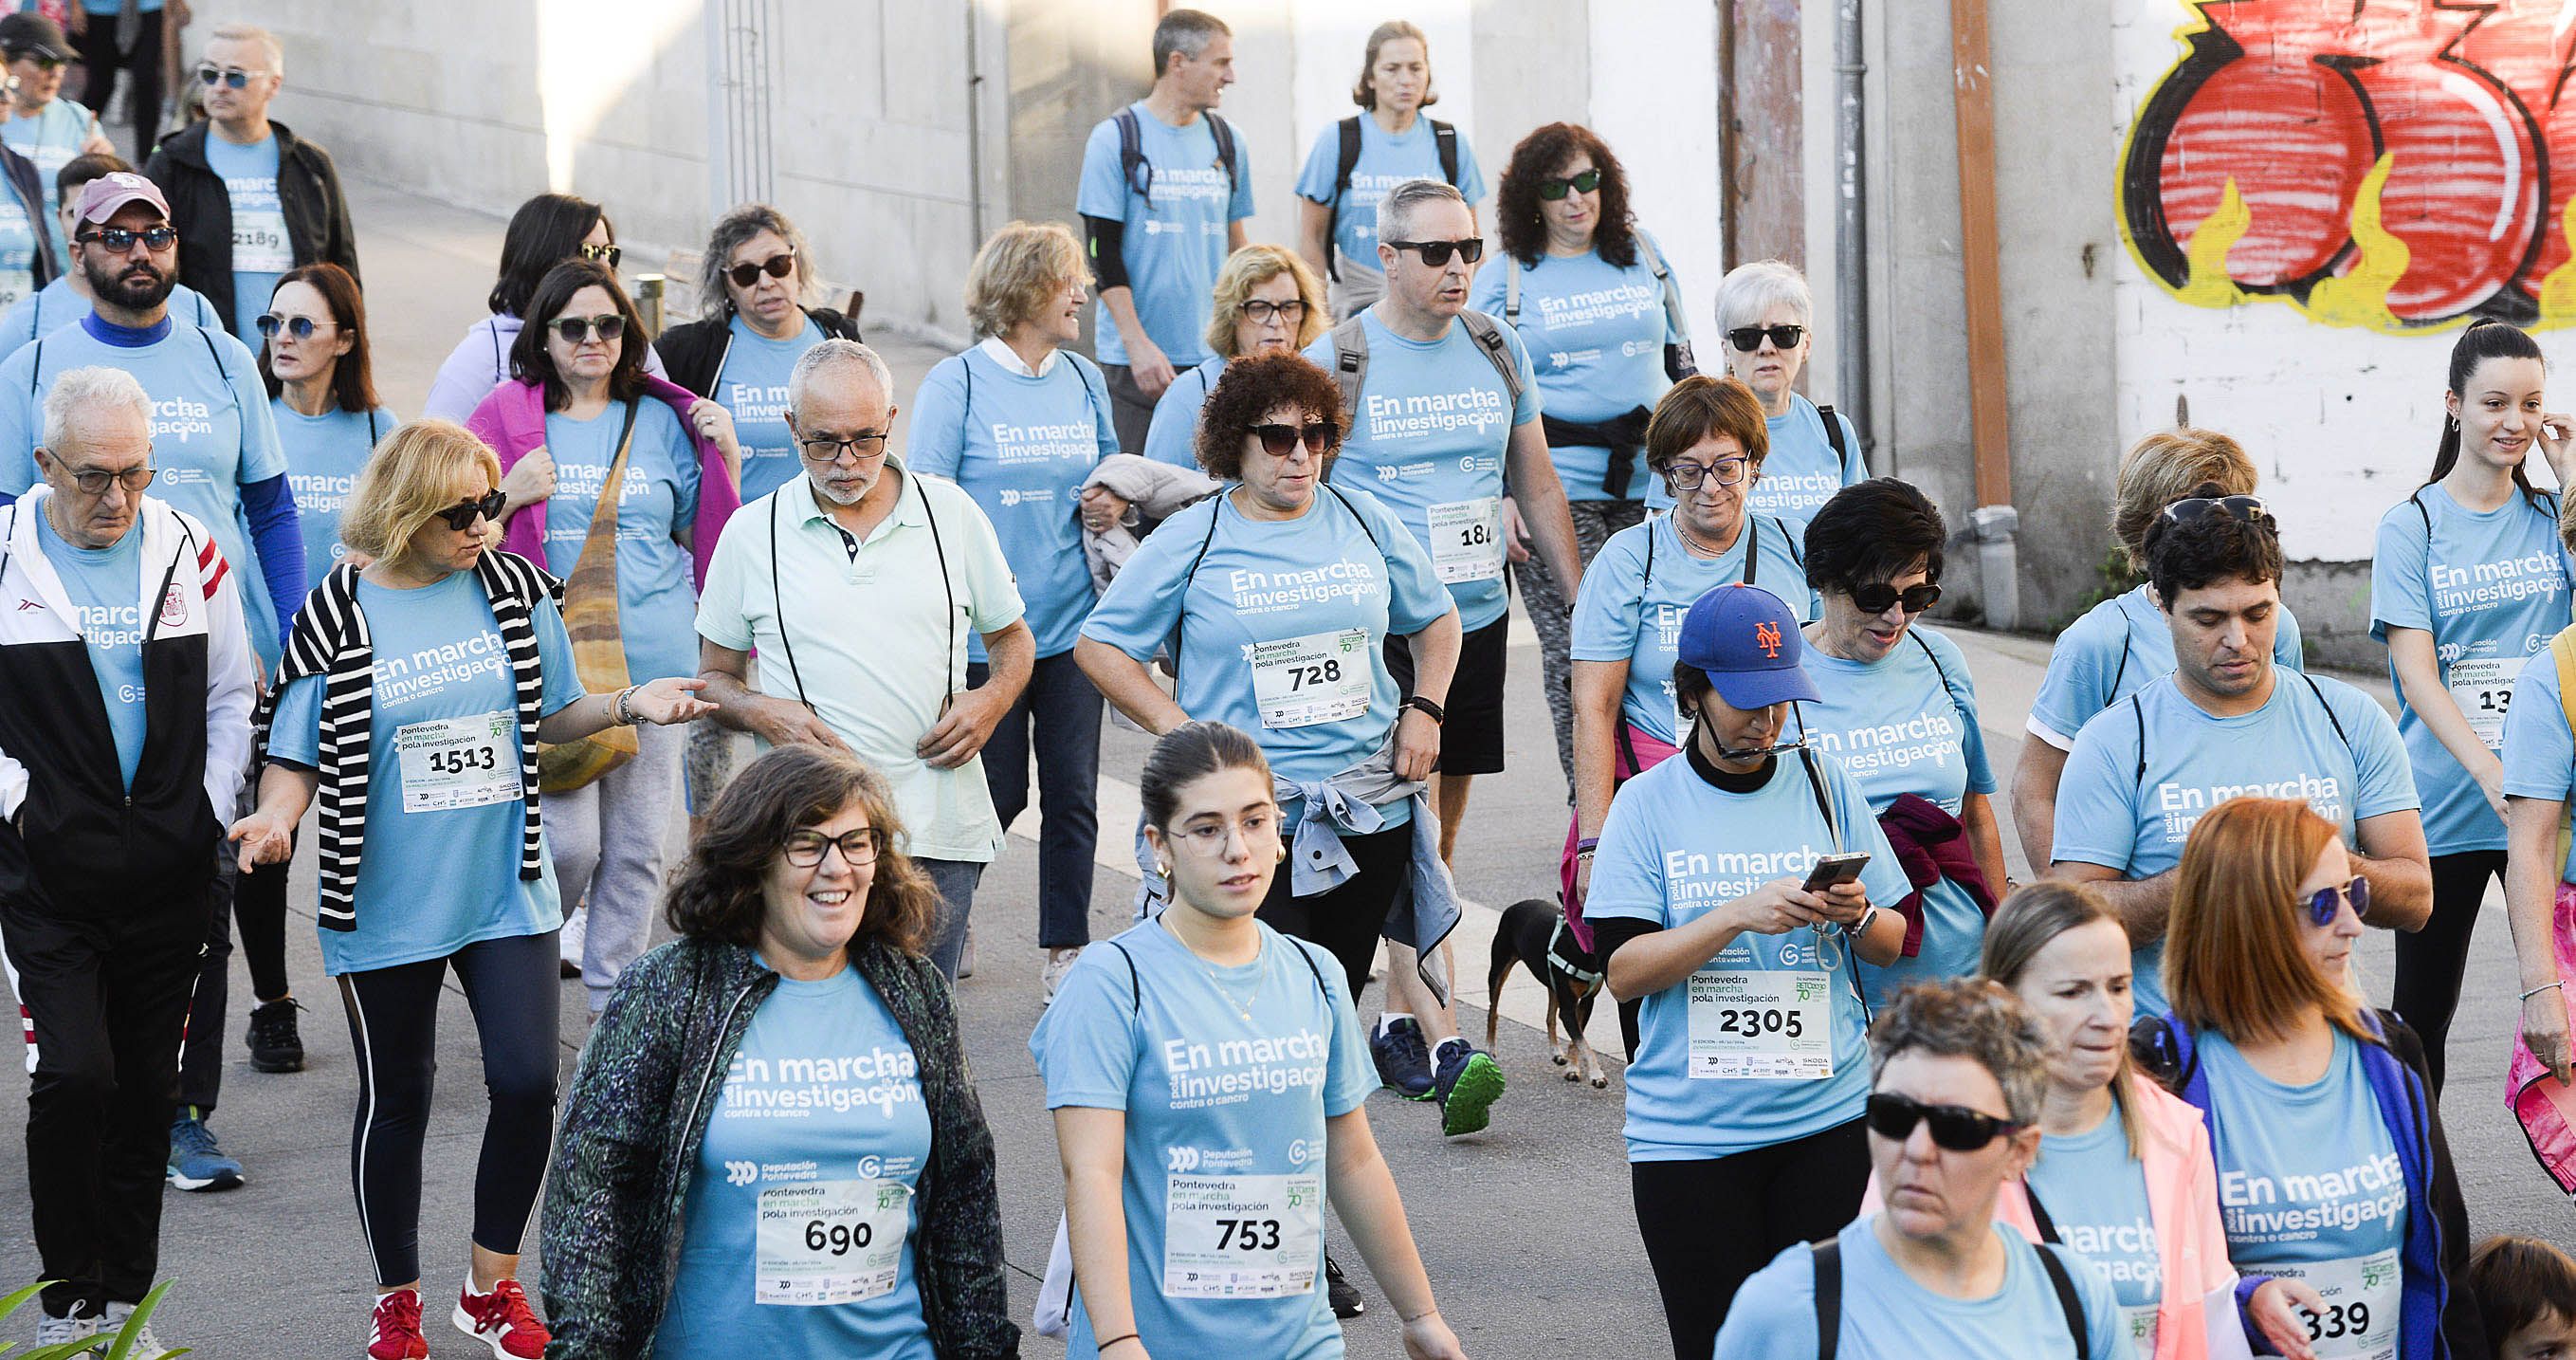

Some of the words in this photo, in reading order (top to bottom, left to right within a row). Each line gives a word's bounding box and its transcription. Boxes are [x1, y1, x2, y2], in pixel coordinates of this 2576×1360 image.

[233, 232, 278, 248] 2189
[1538, 297, 1568, 313] En
[1571, 284, 1651, 307] marcha
[732, 384, 762, 403] En
[1367, 395, 1401, 416] En
[1406, 387, 1501, 414] marcha
[153, 396, 209, 418] rcha
[1378, 408, 1504, 432] investigación
[993, 424, 1024, 443] En
[560, 464, 647, 480] mara
[289, 474, 353, 492] marc
[1745, 491, 1824, 510] vestigac
[1230, 569, 1268, 592] En
[1273, 557, 1373, 587] marcha
[2431, 564, 2469, 590] En
[1243, 579, 1379, 607] investigación
[2435, 593, 2444, 609] pola
[73, 602, 141, 625] marc
[1236, 607, 1263, 616] contra
[1271, 603, 1299, 612] cancro
[2439, 608, 2464, 617] contra
[2472, 602, 2498, 612] cancro
[372, 658, 409, 683] En
[412, 630, 503, 670] march
[1254, 641, 1300, 653] Pontevedra
[1267, 650, 1297, 658] marcha
[1255, 659, 1273, 670] pola
[1275, 652, 1327, 664] investigación
[383, 651, 512, 698] investigació
[1288, 659, 1341, 691] 728
[2452, 679, 2471, 688] pola
[2472, 678, 2515, 687] investigac
[382, 696, 410, 708] contra
[416, 686, 445, 698] cancro
[401, 724, 448, 735] Pontevedra
[1850, 711, 1954, 749] marcha
[402, 742, 421, 751] pola
[422, 736, 476, 747] investigación
[429, 746, 495, 773] 1513
[1838, 738, 1960, 769] vestigación
[2159, 782, 2203, 810] En
[1666, 849, 1709, 878] En
[1717, 845, 1820, 874] march
[1670, 880, 1681, 900] pola
[1680, 876, 1767, 899] investi
[1672, 901, 1702, 910] contra
[1692, 975, 1748, 984] Pontevedra
[1692, 994, 1713, 1003] pola
[1715, 994, 1780, 1004] investigación
[1797, 990, 1810, 1002] 70
[1720, 1009, 1802, 1038] 2305
[778, 1047, 915, 1082] marcha
[1164, 1038, 1212, 1074] En
[736, 1079, 919, 1112] investigación
[1170, 1098, 1204, 1109] contra
[1215, 1094, 1249, 1105] cancro
[724, 1110, 761, 1118] contra
[773, 1109, 810, 1117] cancro
[1202, 1149, 1252, 1161] Deputación
[1202, 1158, 1252, 1168] Pontevedra
[762, 1160, 817, 1173] Deputación
[762, 1171, 817, 1181] Pontevedra
[1173, 1179, 1235, 1189] Pontevedra
[2221, 1170, 2276, 1205] En
[779, 1198, 819, 1206] marcha
[1172, 1202, 1196, 1211] pola
[1198, 1202, 1269, 1214] investigación
[2238, 1185, 2406, 1234] investigació
[762, 1207, 787, 1221] pola
[790, 1205, 858, 1219] investigación
[806, 1221, 872, 1256] 690
[1215, 1219, 1280, 1251] 753
[2055, 1216, 2155, 1253] arch
[2228, 1233, 2266, 1243] contra
[2278, 1231, 2317, 1241] cancro
[2300, 1302, 2369, 1341] 339
